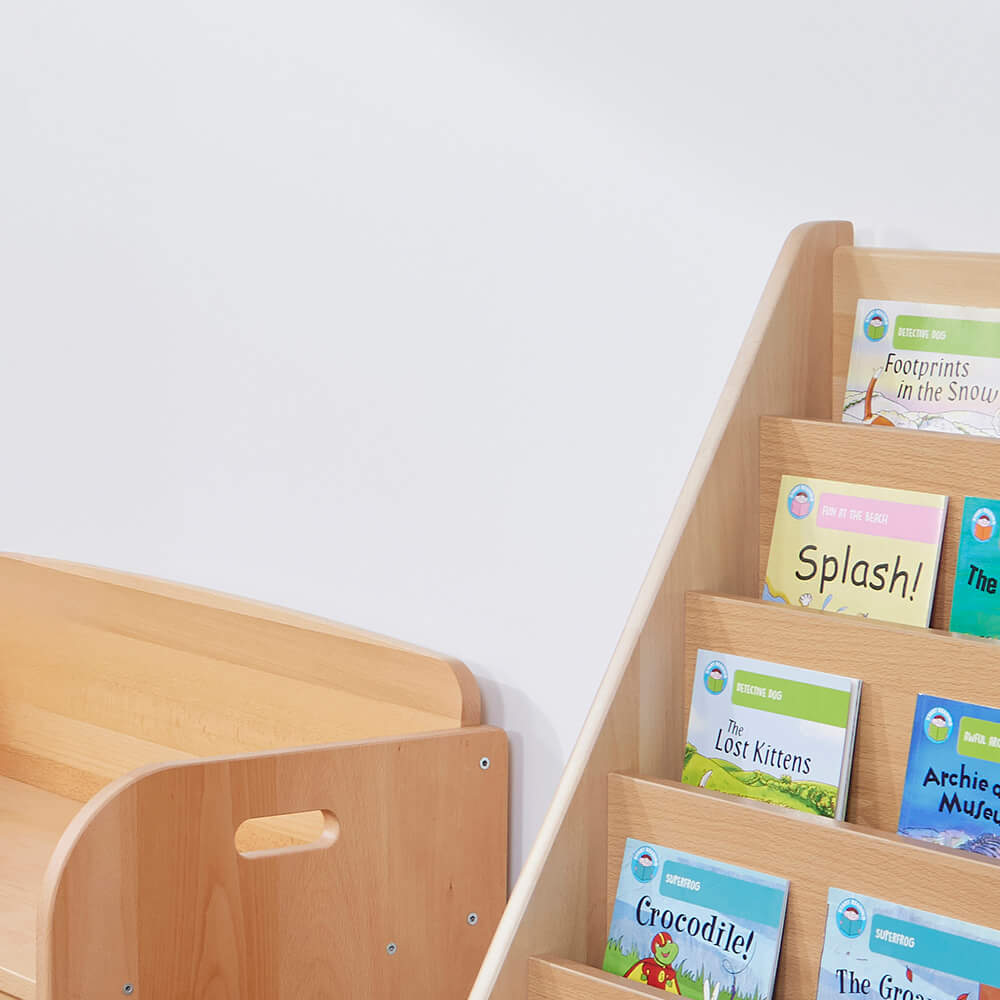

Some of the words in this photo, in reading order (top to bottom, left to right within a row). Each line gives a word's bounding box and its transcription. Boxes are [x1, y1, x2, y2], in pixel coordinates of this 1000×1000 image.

[898, 328, 928, 339] DETECTIVE
[932, 330, 946, 340] DOG
[885, 353, 970, 380] Footprints
[898, 380, 912, 399] in
[918, 381, 943, 400] the
[948, 381, 998, 403] Snow
[822, 506, 837, 516] FUN
[838, 508, 848, 518] AT
[849, 510, 863, 520] THE
[865, 512, 888, 525] BEACH
[795, 545, 923, 601] Splash!
[967, 564, 997, 594] The
[736, 683, 766, 698] DETECTIVE
[768, 689, 782, 700] DOG
[728, 719, 744, 736] The
[964, 731, 987, 744] AWFUL
[715, 729, 749, 759] Lost
[753, 740, 812, 774] Kittens
[922, 764, 988, 791] Archie
[665, 874, 700, 891] SUPERFROG
[636, 895, 754, 960] Crocodile!
[875, 929, 915, 948] SUPERFROG
[836, 969, 871, 994] The
